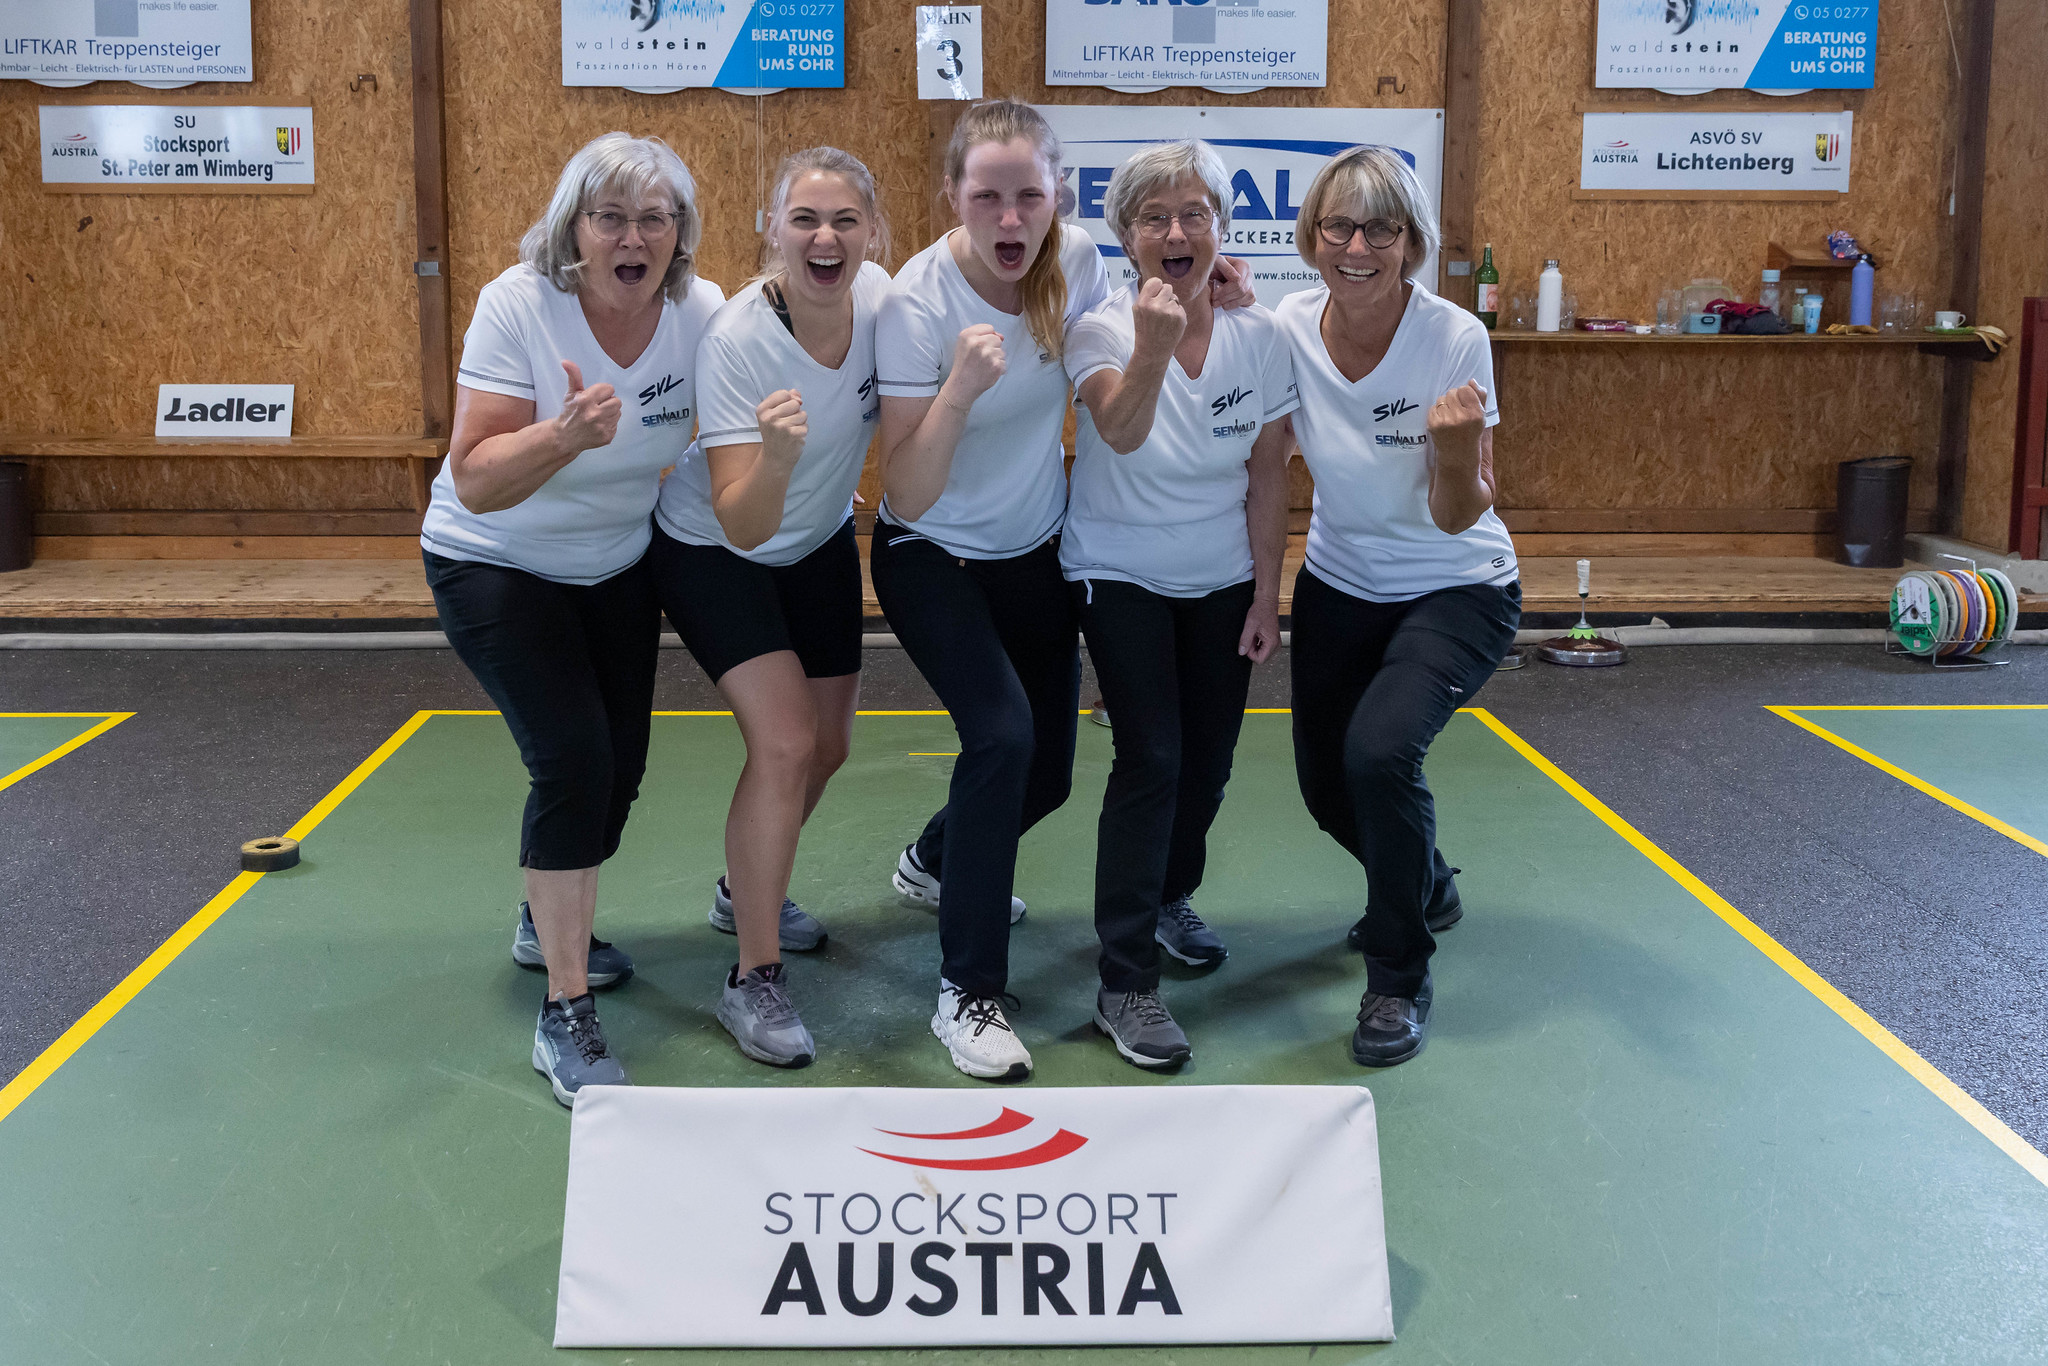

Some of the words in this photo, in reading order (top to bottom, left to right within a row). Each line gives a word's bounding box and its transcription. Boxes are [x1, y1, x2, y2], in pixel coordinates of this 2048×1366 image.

[139, 2, 171, 11] makes
[173, 2, 187, 11] life
[189, 3, 220, 11] easier.
[779, 4, 797, 17] 05
[800, 4, 835, 17] 0277
[1217, 8, 1250, 18] makes
[1251, 8, 1265, 18] life
[1266, 8, 1297, 18] easier.
[1812, 7, 1828, 19] 05
[1831, 7, 1870, 19] 0277
[751, 29, 835, 42] BERATUNG
[1783, 31, 1867, 45] BERATUNG
[4, 38, 78, 55] LIFTKAR
[85, 39, 222, 61] Treppensteiger
[576, 37, 707, 51] waldstein
[788, 44, 835, 57] RUND
[1610, 40, 1740, 53] waldstein
[1083, 45, 1155, 62] LIFTKAR
[1162, 46, 1297, 67] Treppensteiger
[1819, 46, 1867, 59] RUND
[576, 61, 659, 71] Faszination
[666, 61, 707, 71] Hören
[758, 58, 795, 71] UMS
[799, 58, 835, 71] OHR
[936, 39, 964, 81] 3
[1790, 60, 1826, 74] UMS
[1830, 60, 1866, 74] OHR
[0, 63, 31, 72] hmbar
[40, 63, 68, 73] Leicht
[124, 64, 137, 74] für
[139, 65, 174, 74] LASTEN
[176, 65, 195, 74] und
[196, 65, 247, 75] PERSONEN
[1052, 69, 1109, 80] Mitnehmbar
[1117, 70, 1145, 80] Leicht
[1200, 70, 1214, 81] für
[1215, 71, 1250, 81] LASTEN
[1251, 71, 1270, 81] und
[1271, 71, 1320, 81] PERSONEN
[1609, 64, 1691, 74] Faszination
[1699, 64, 1740, 74] Hören
[174, 115, 197, 129] SU
[1690, 128, 1737, 145] ASVÖ
[1741, 131, 1764, 145] SV
[51, 148, 99, 157] AUSTRIA
[143, 135, 231, 157] Stocksport
[1592, 154, 1639, 163] AUSTRIA
[1656, 152, 1795, 175] Lichtenberg
[101, 158, 123, 177] St.
[128, 159, 171, 178] Peter
[175, 163, 199, 178] am
[203, 159, 274, 182] Wimberg
[638, 374, 685, 407] SVL
[1210, 385, 1254, 417] SVL
[163, 397, 286, 423] Ladler
[1372, 397, 1420, 423] SVL
[763, 1191, 1179, 1236] STOCKSPORT
[760, 1240, 1184, 1317] AUSTRIA
